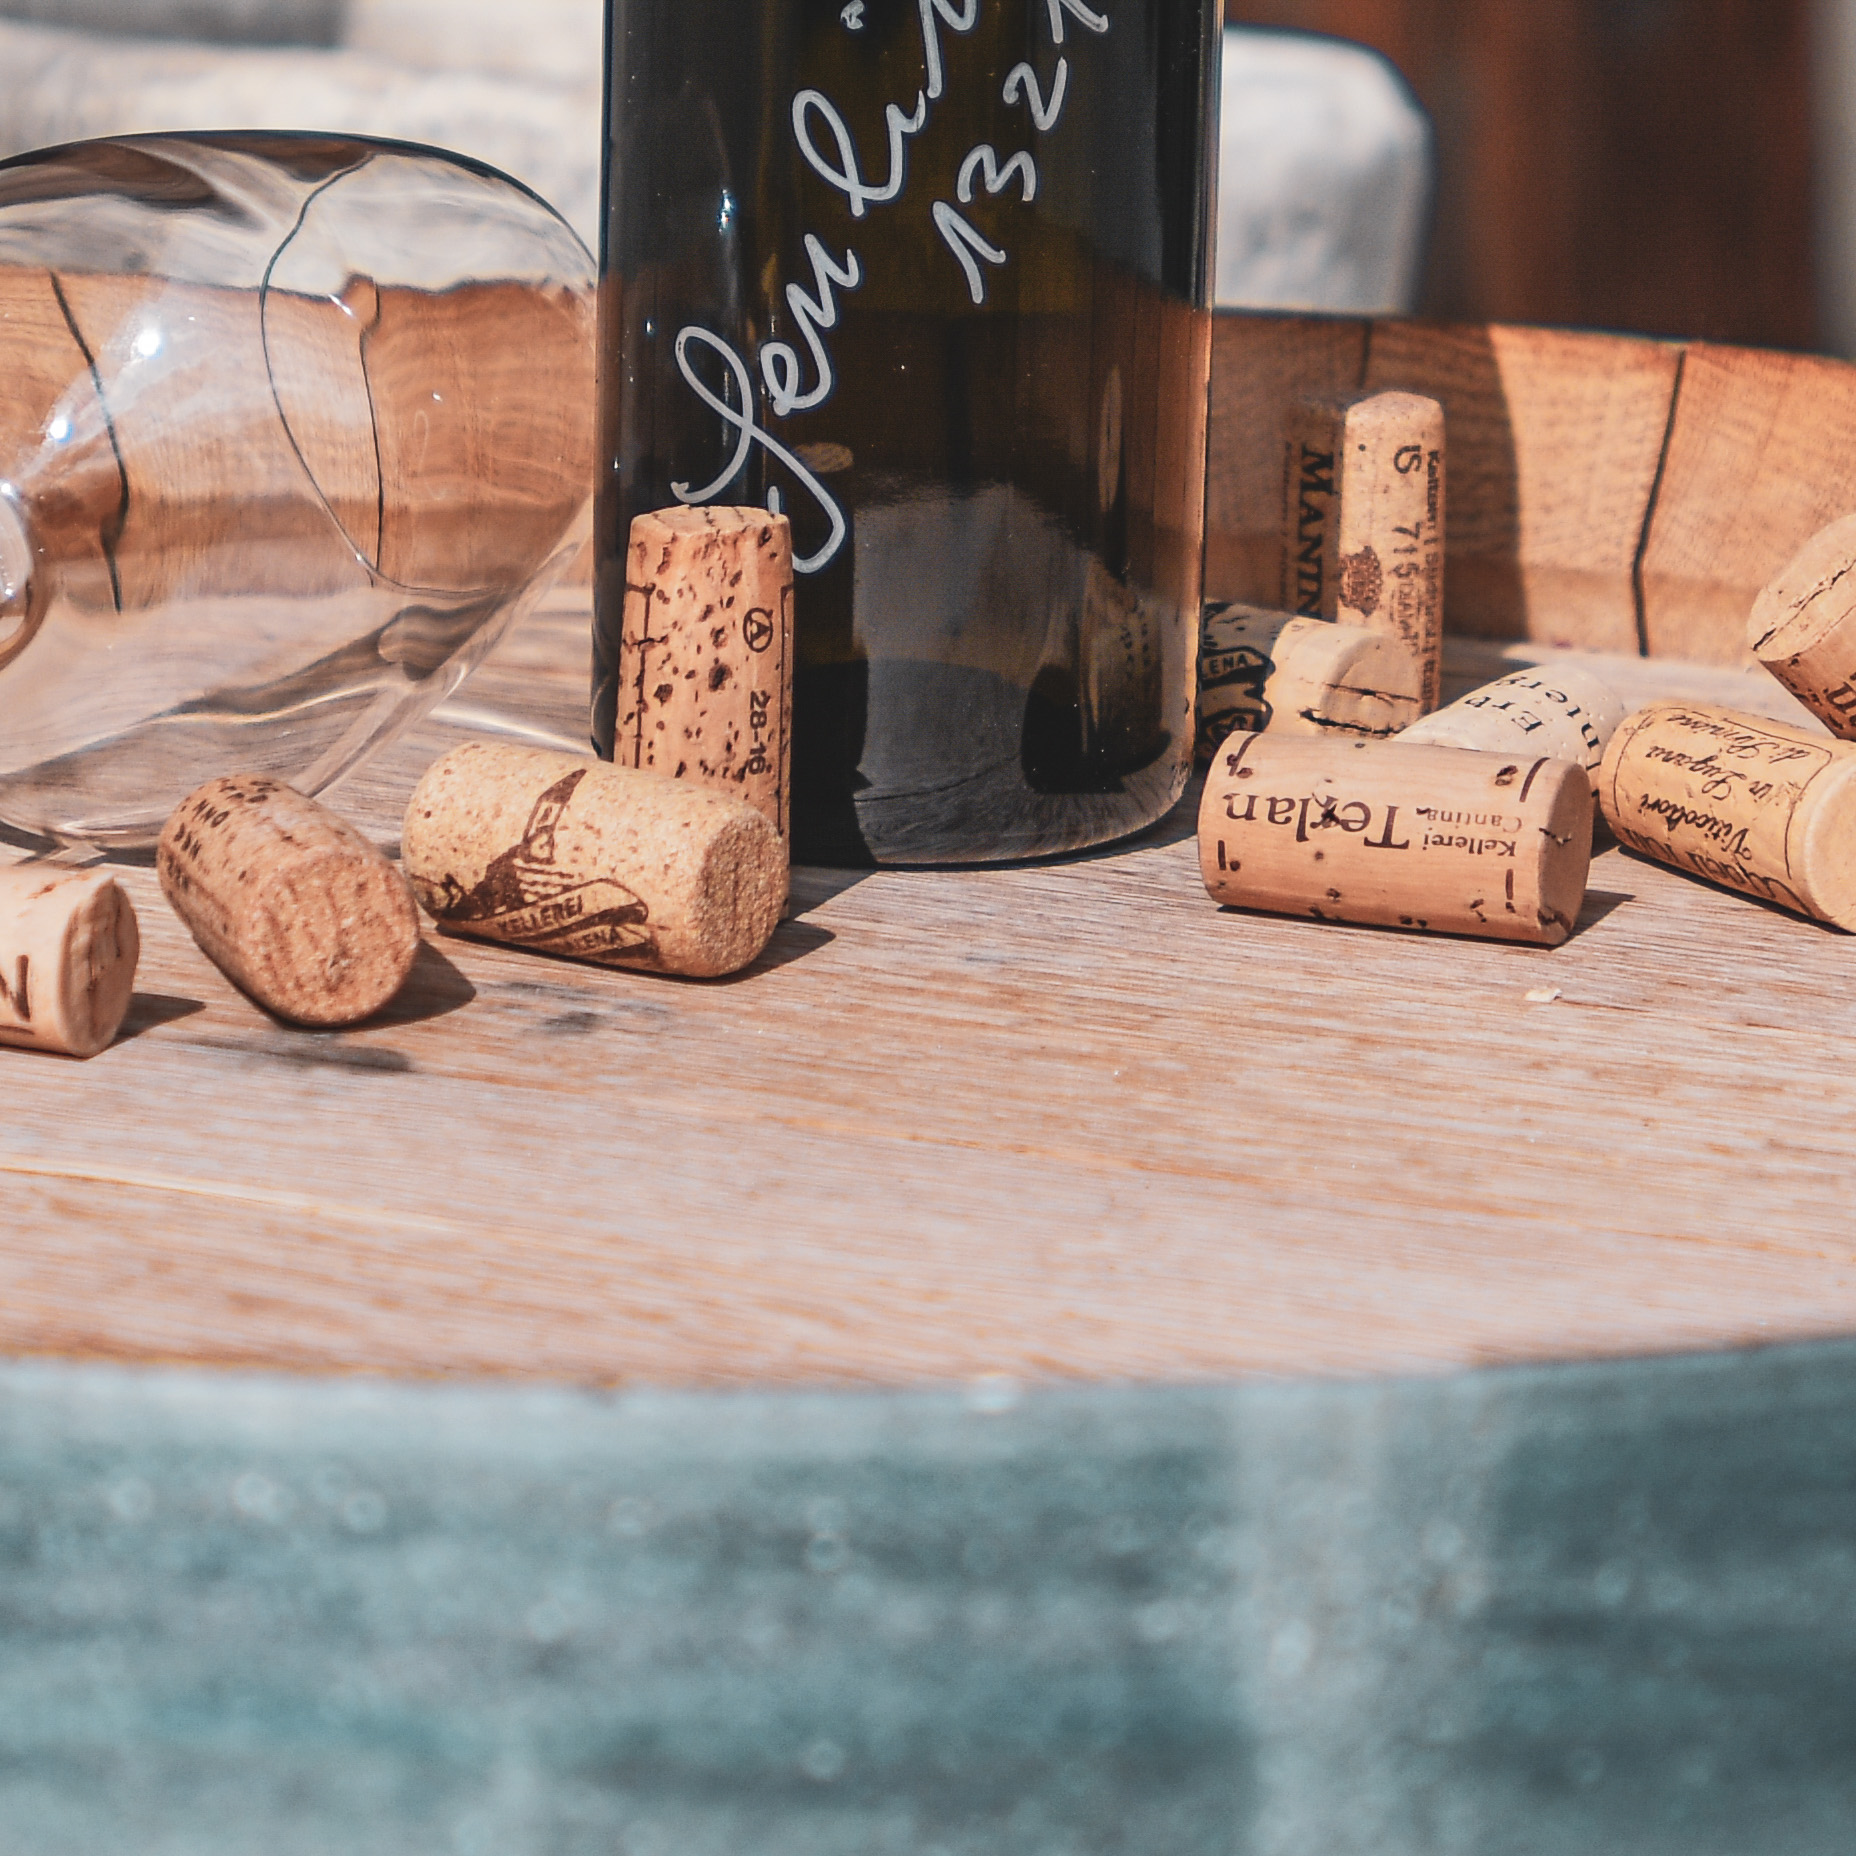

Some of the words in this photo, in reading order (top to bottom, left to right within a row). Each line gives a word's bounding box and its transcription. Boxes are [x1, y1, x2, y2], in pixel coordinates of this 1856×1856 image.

[748, 690, 769, 776] 28-16
[1222, 792, 1410, 850] Terlan
[1423, 808, 1523, 834] Cantina
[1422, 830, 1518, 858] Kellerei
